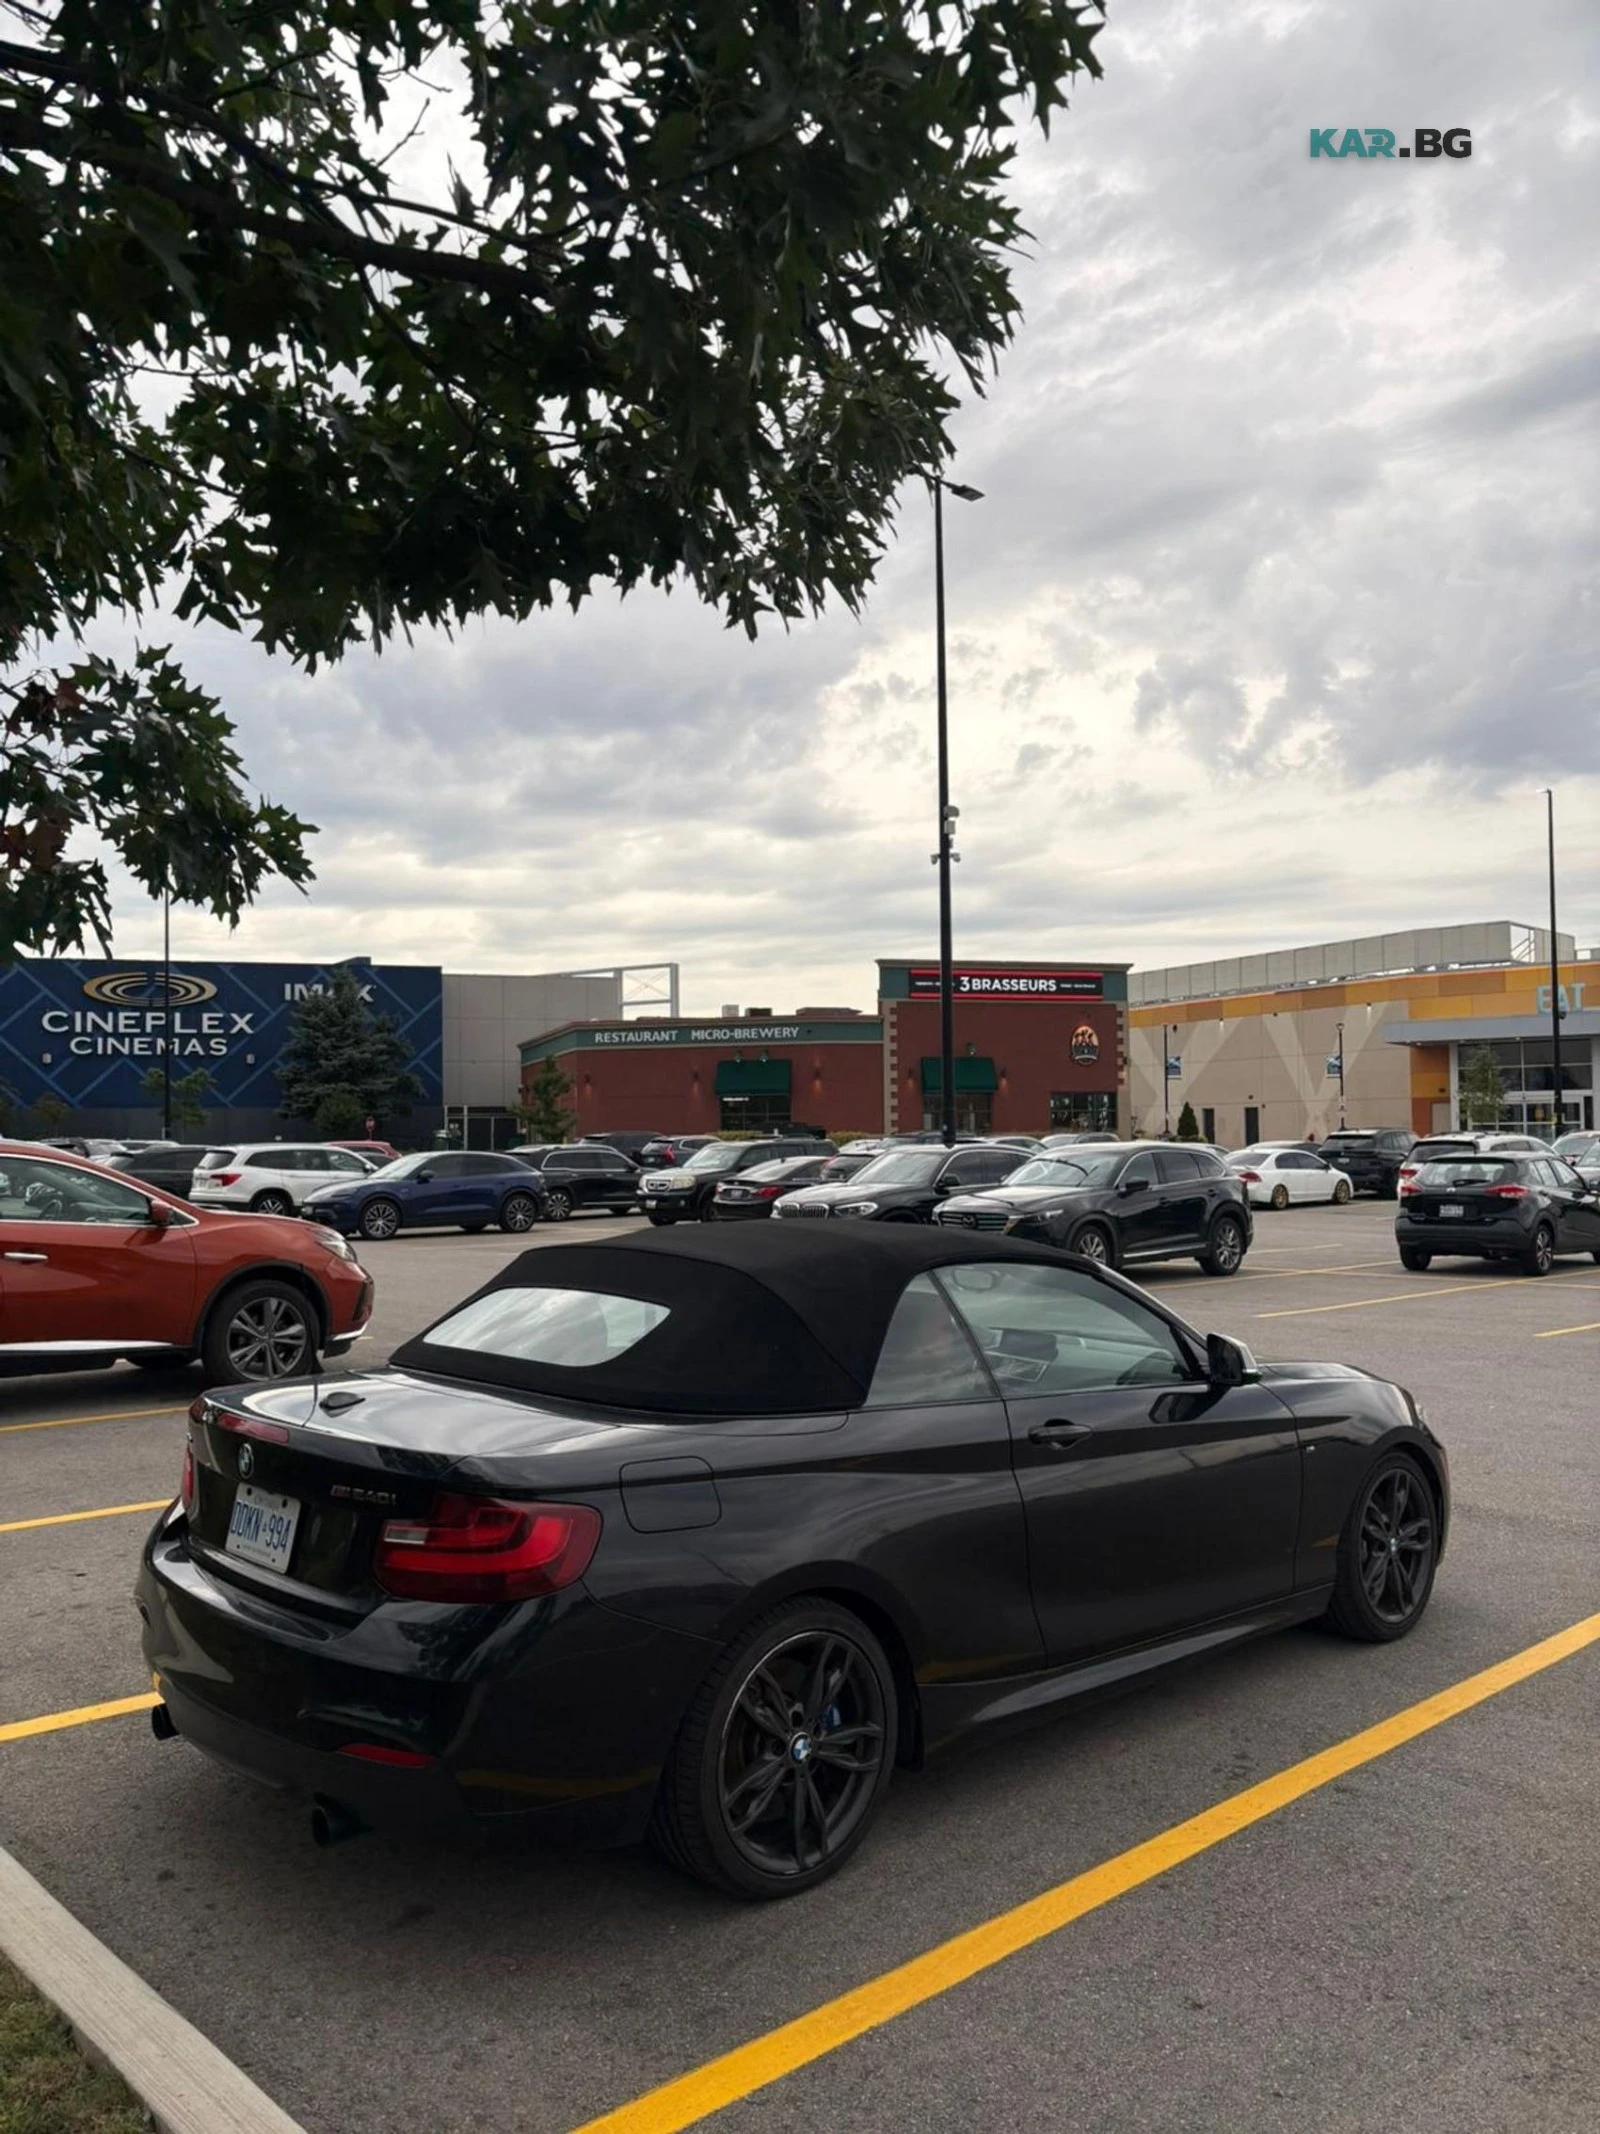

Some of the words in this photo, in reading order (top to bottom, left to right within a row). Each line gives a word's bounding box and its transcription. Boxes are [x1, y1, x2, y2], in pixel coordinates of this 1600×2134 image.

[284, 983, 374, 1003] IMX
[41, 1011, 254, 1034] CINEPLEX
[594, 1030, 678, 1043] RESTAURANT
[691, 1026, 799, 1040] MICRO-BREWERY
[70, 1036, 228, 1056] CINEMAS
